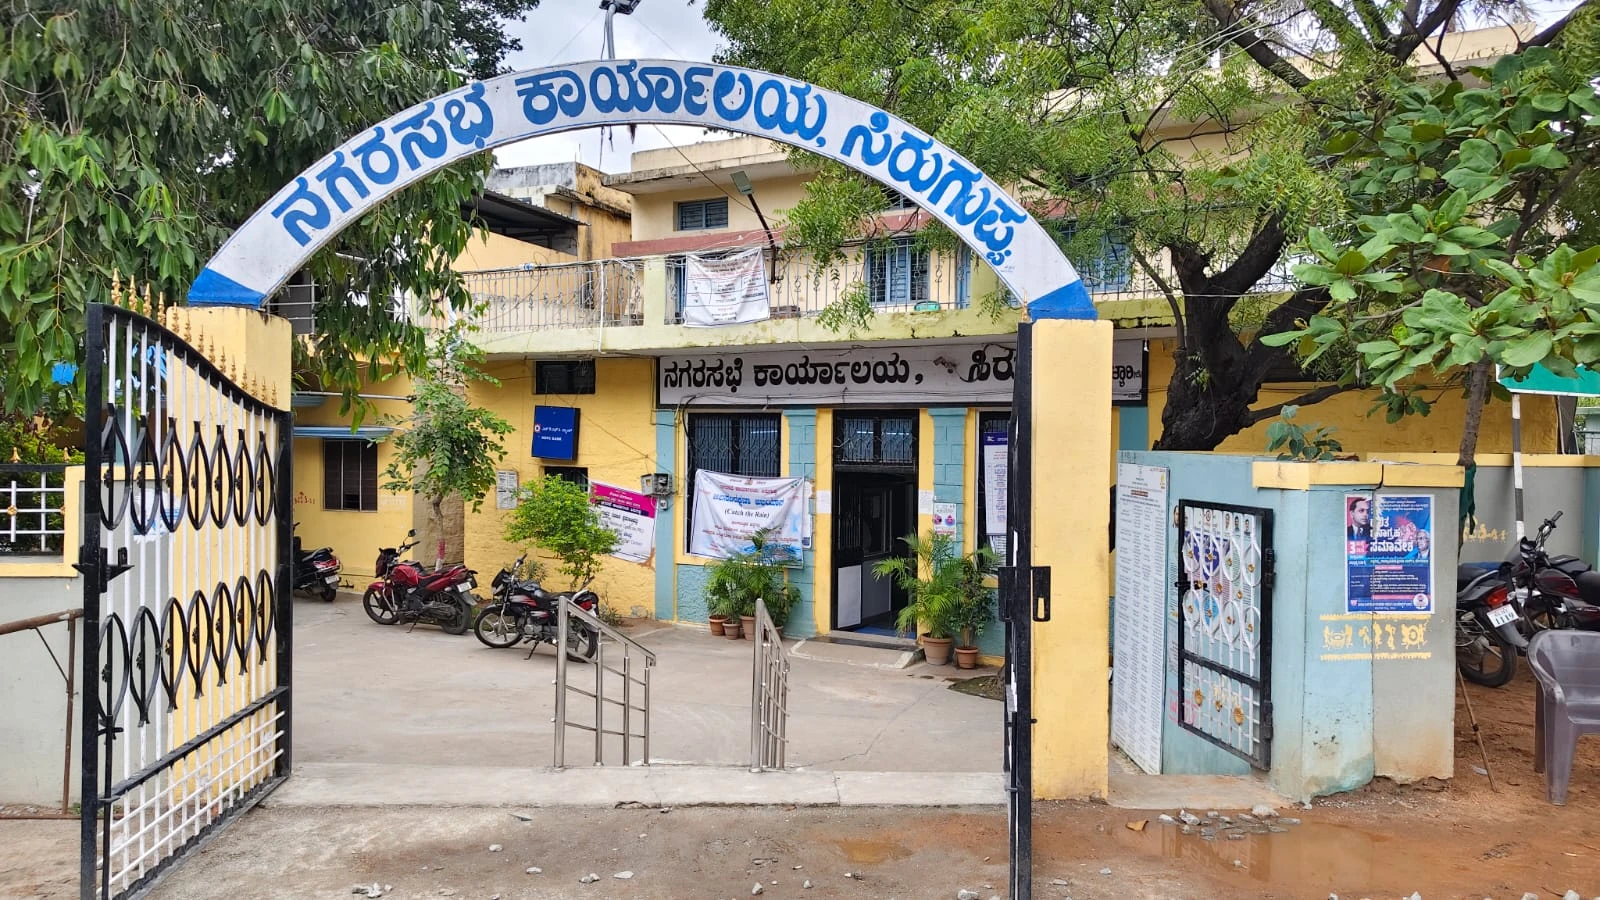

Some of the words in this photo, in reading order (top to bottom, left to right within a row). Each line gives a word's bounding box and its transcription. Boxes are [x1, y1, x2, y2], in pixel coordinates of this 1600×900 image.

[271, 82, 494, 247] ನಗರಸಭೆ
[515, 59, 827, 148] ಕಾರ್ಯಾಲಯ,
[840, 111, 1027, 267] ಸಿರುಗುಪ್ಪ
[664, 357, 743, 393] ನಗರಸಭೆ
[753, 352, 924, 387] ಕಾರ್ಯಾಲಯ,
[1349, 541, 1356, 554] 3
